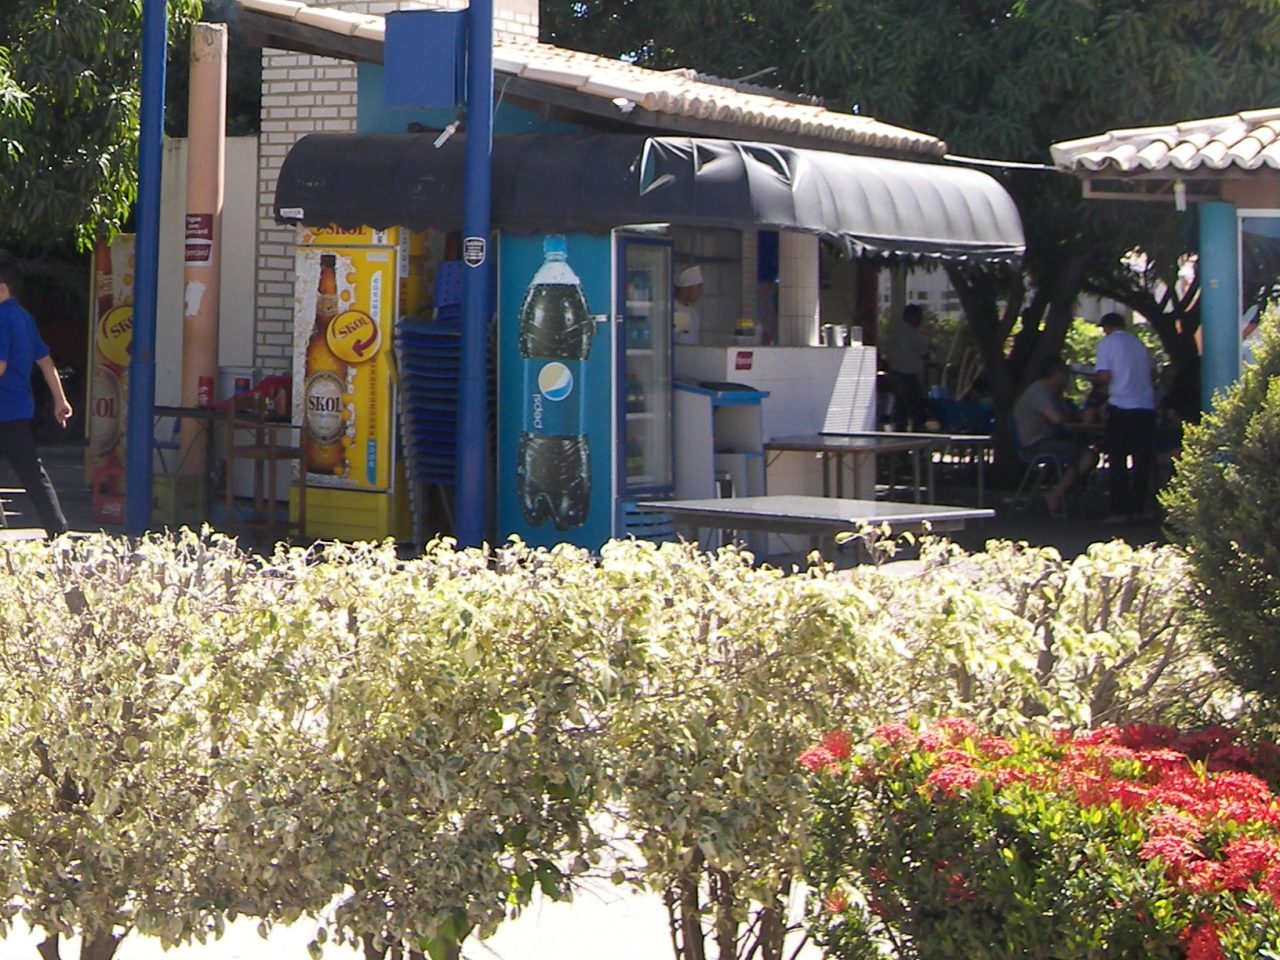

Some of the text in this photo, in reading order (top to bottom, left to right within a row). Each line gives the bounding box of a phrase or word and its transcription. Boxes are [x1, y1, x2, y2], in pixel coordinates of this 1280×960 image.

[371, 278, 379, 318] GELADA
[338, 316, 370, 338] SKOL
[91, 397, 117, 419] OL
[308, 396, 342, 413] SKOL
[533, 394, 543, 429] pepsi
